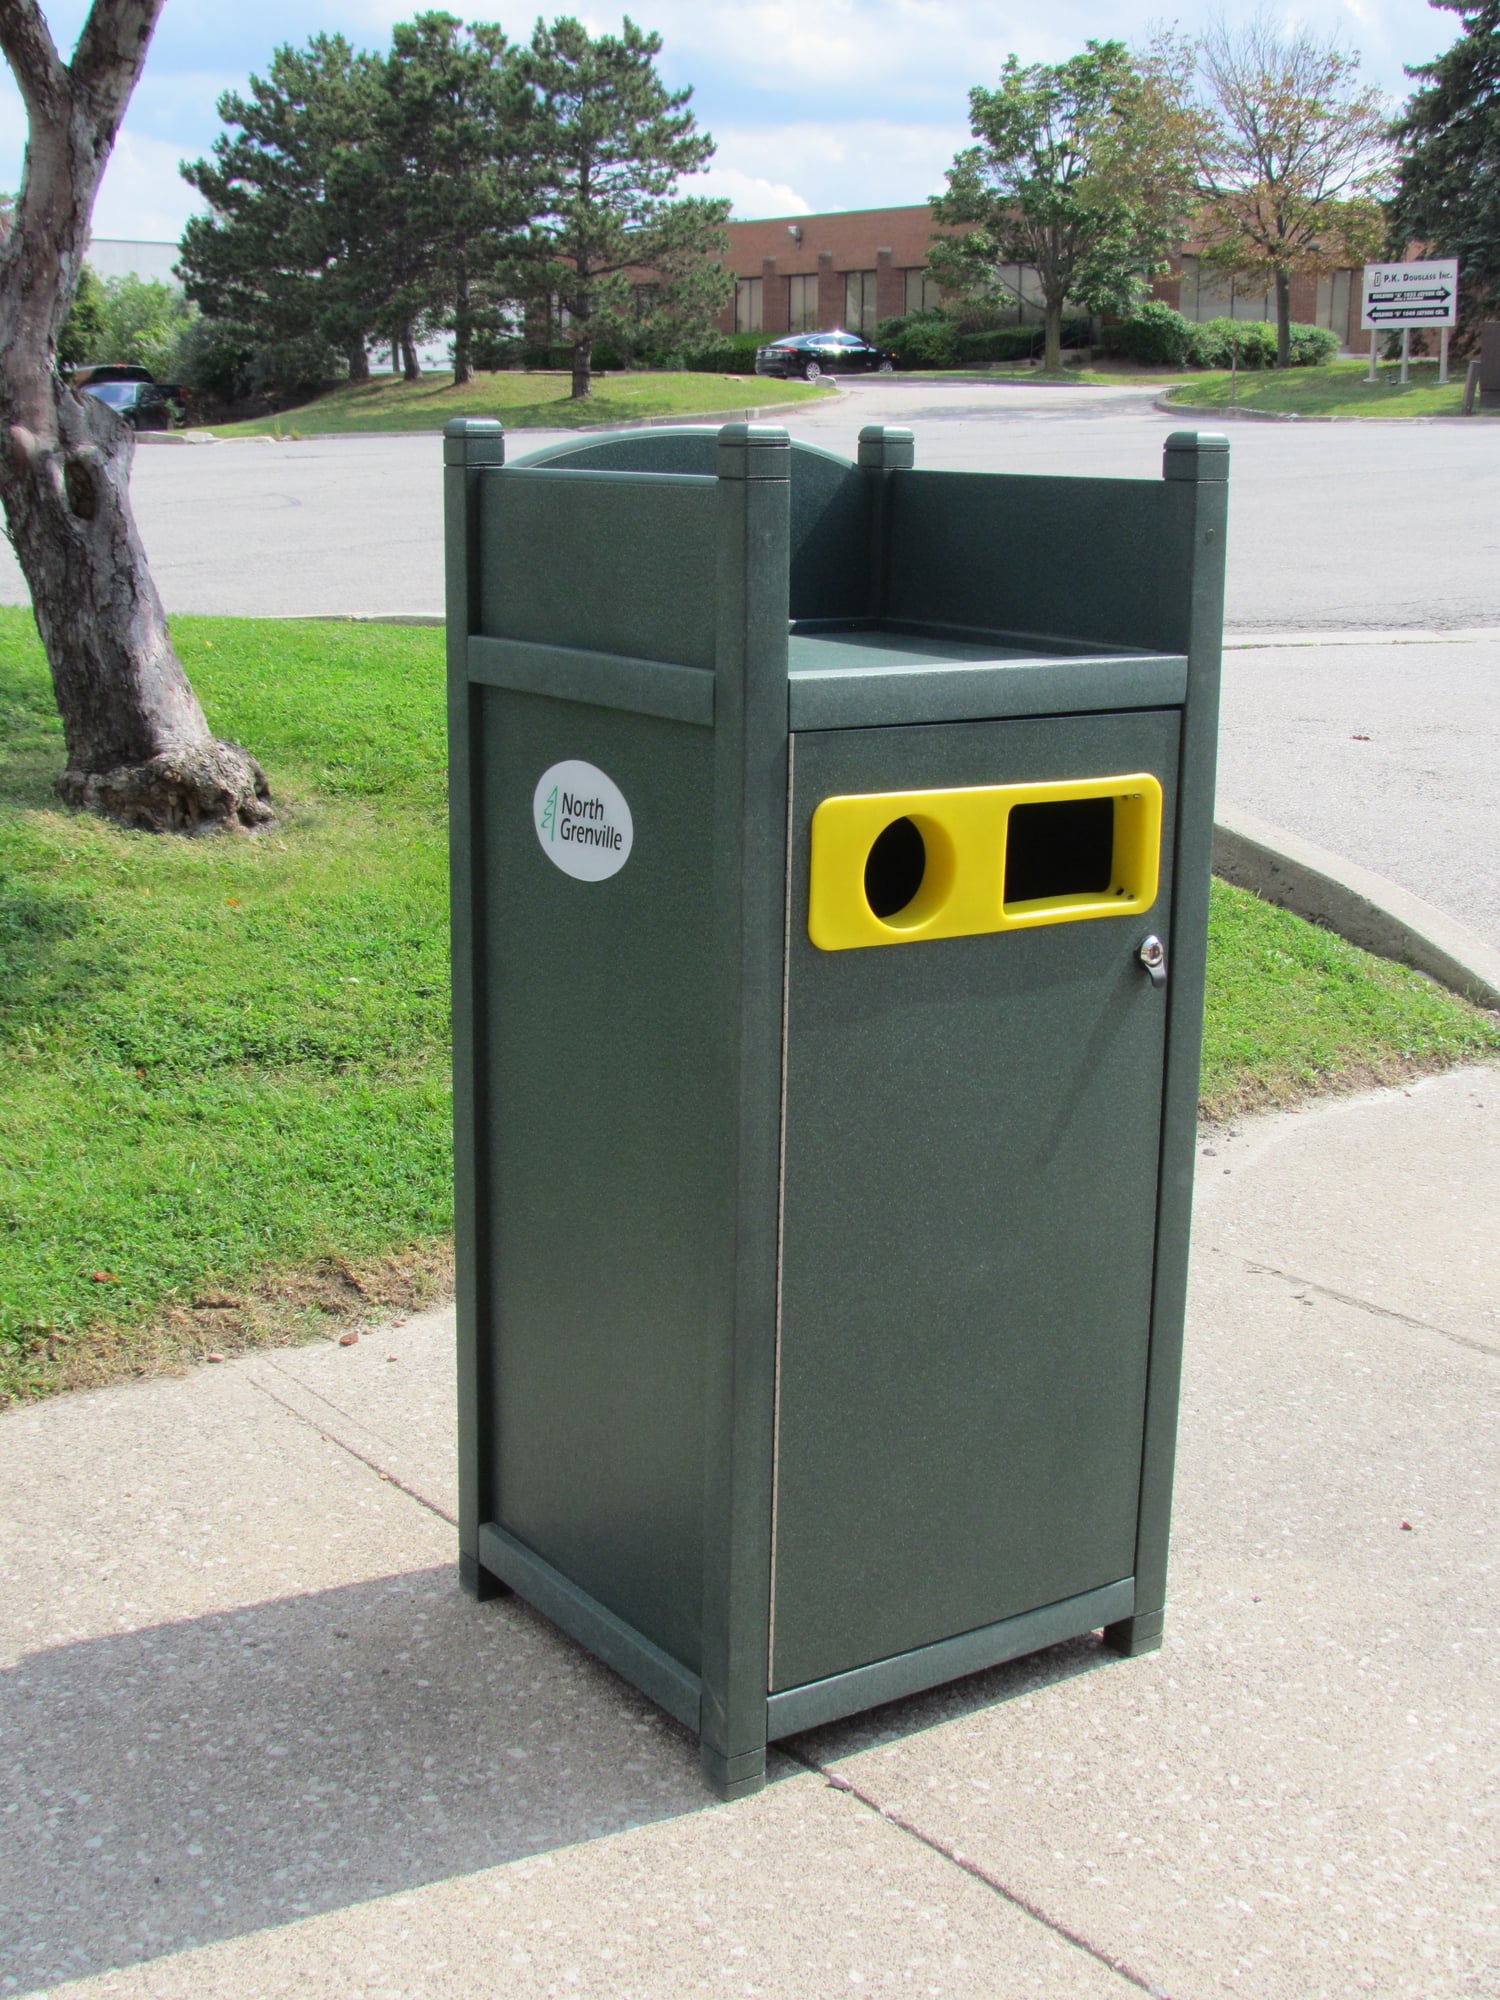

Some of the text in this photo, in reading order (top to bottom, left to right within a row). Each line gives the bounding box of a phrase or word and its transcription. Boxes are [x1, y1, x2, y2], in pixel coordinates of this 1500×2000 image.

[1384, 273, 1400, 283] P.K.
[561, 792, 605, 821] North
[560, 818, 623, 851] Grenville
